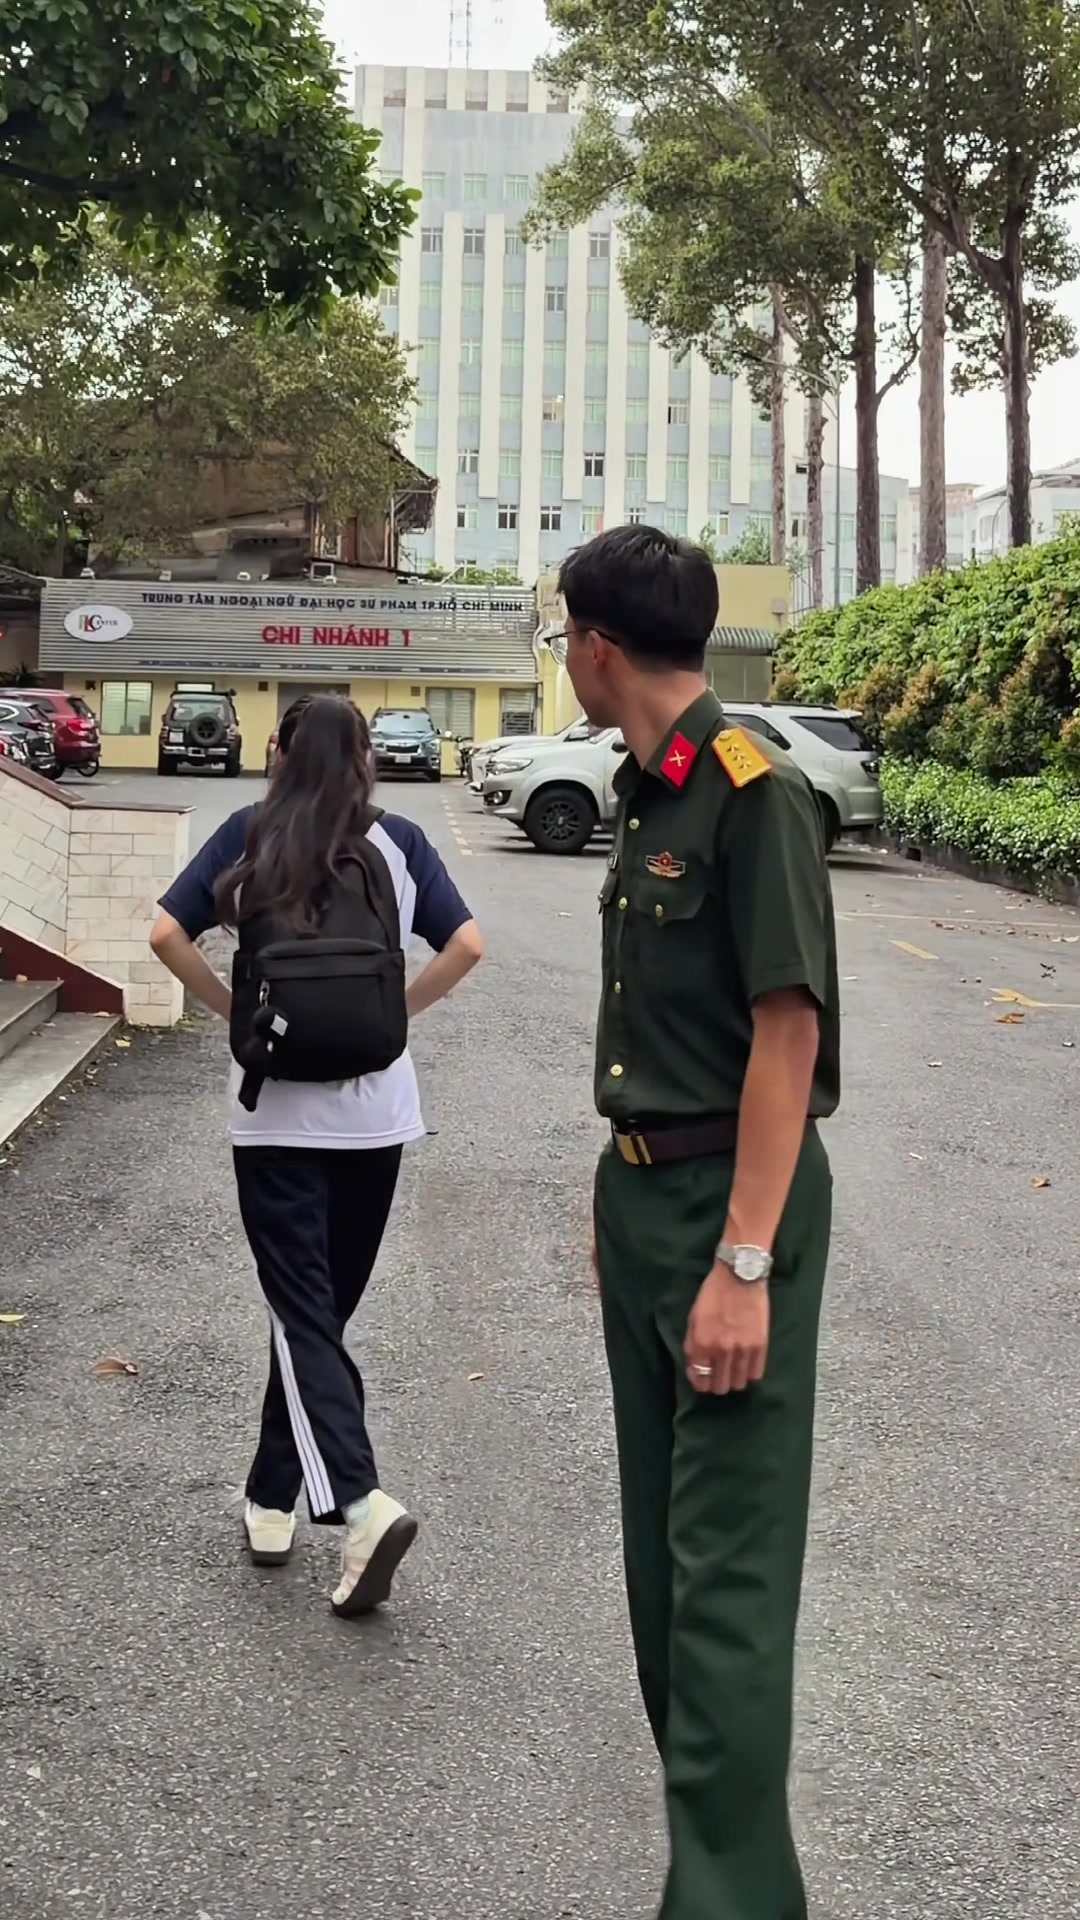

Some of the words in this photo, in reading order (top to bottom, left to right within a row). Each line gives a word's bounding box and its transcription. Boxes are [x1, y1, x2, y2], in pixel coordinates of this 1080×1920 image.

[142, 593, 183, 603] TRUNG
[188, 593, 214, 605] TÂM
[219, 596, 262, 608] NGOẠI
[267, 594, 295, 606] NGỮ
[327, 598, 355, 612] HỌC
[462, 600, 485, 611] CHÍ
[489, 601, 523, 612] MINH
[262, 625, 302, 646] CHI
[312, 624, 390, 648] NHÁNH
[401, 629, 412, 648] 1
